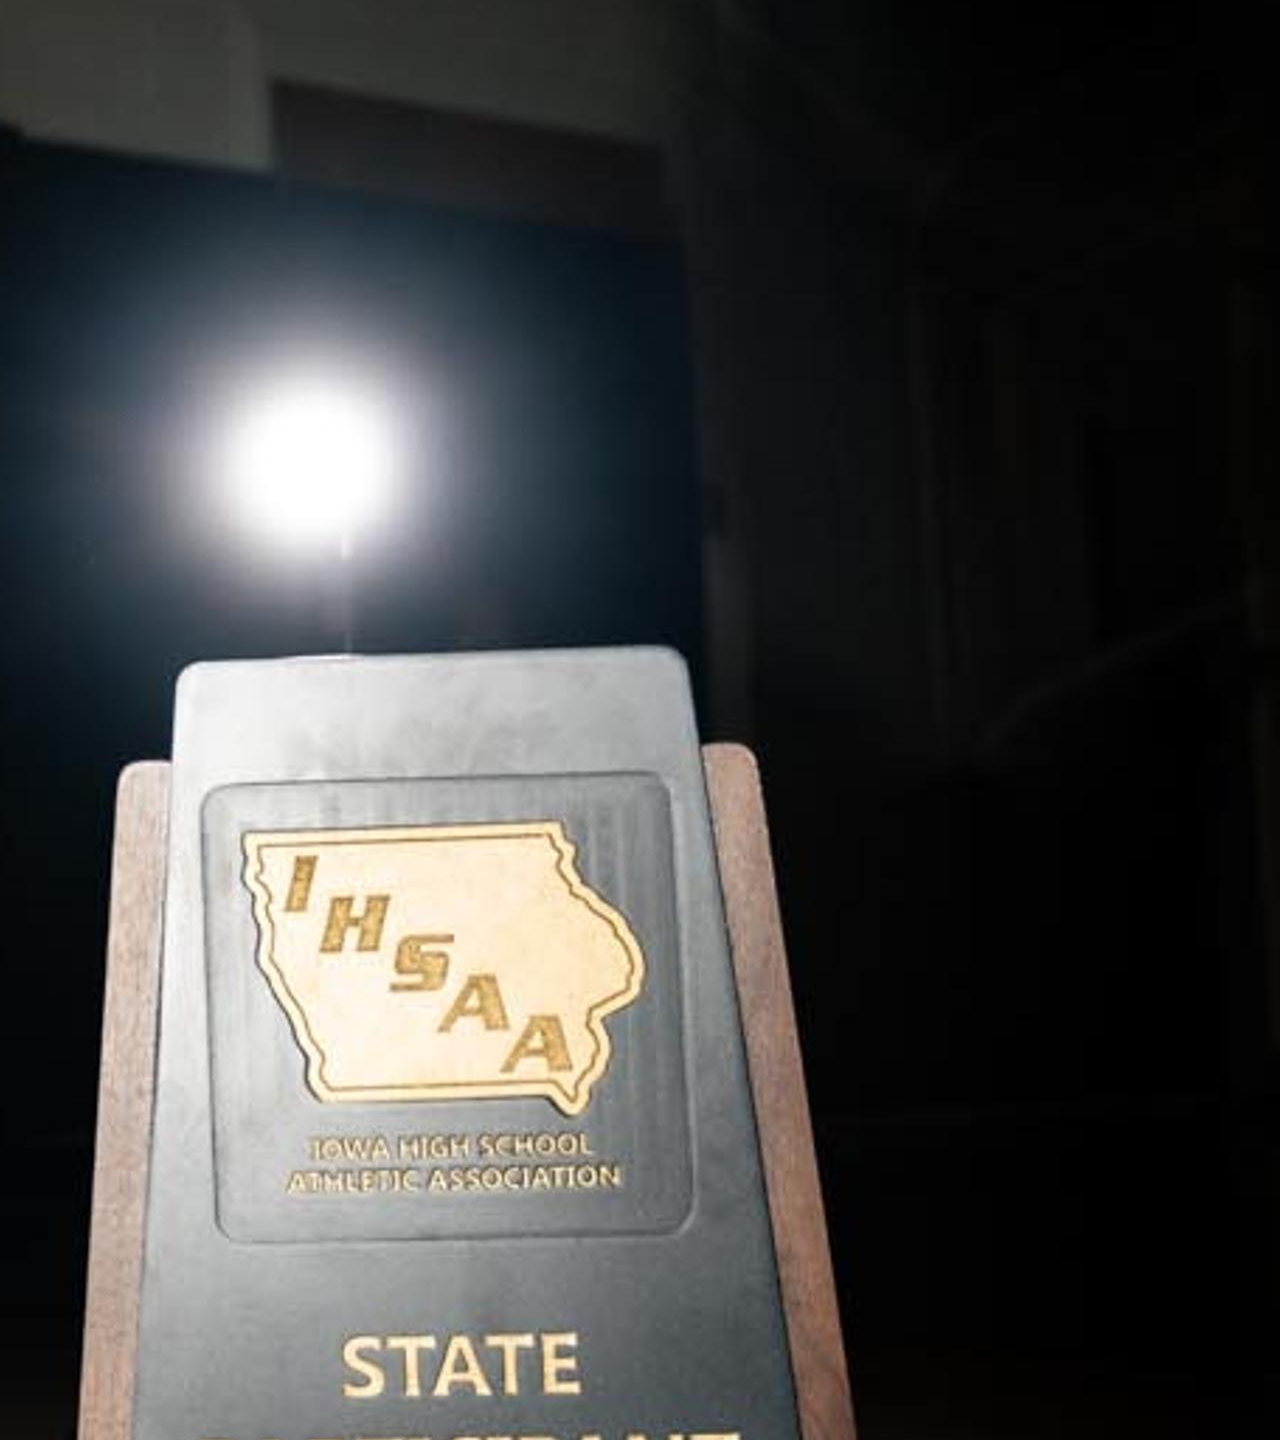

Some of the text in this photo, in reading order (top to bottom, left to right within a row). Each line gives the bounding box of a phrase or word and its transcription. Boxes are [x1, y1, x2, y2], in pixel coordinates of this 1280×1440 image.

[283, 854, 574, 1074] IHSAA
[309, 1133, 595, 1161] IOWA HIGH SCHOOL
[287, 1164, 622, 1195] ATHLETIC ASSOCIATION
[341, 1330, 582, 1399] STATE
